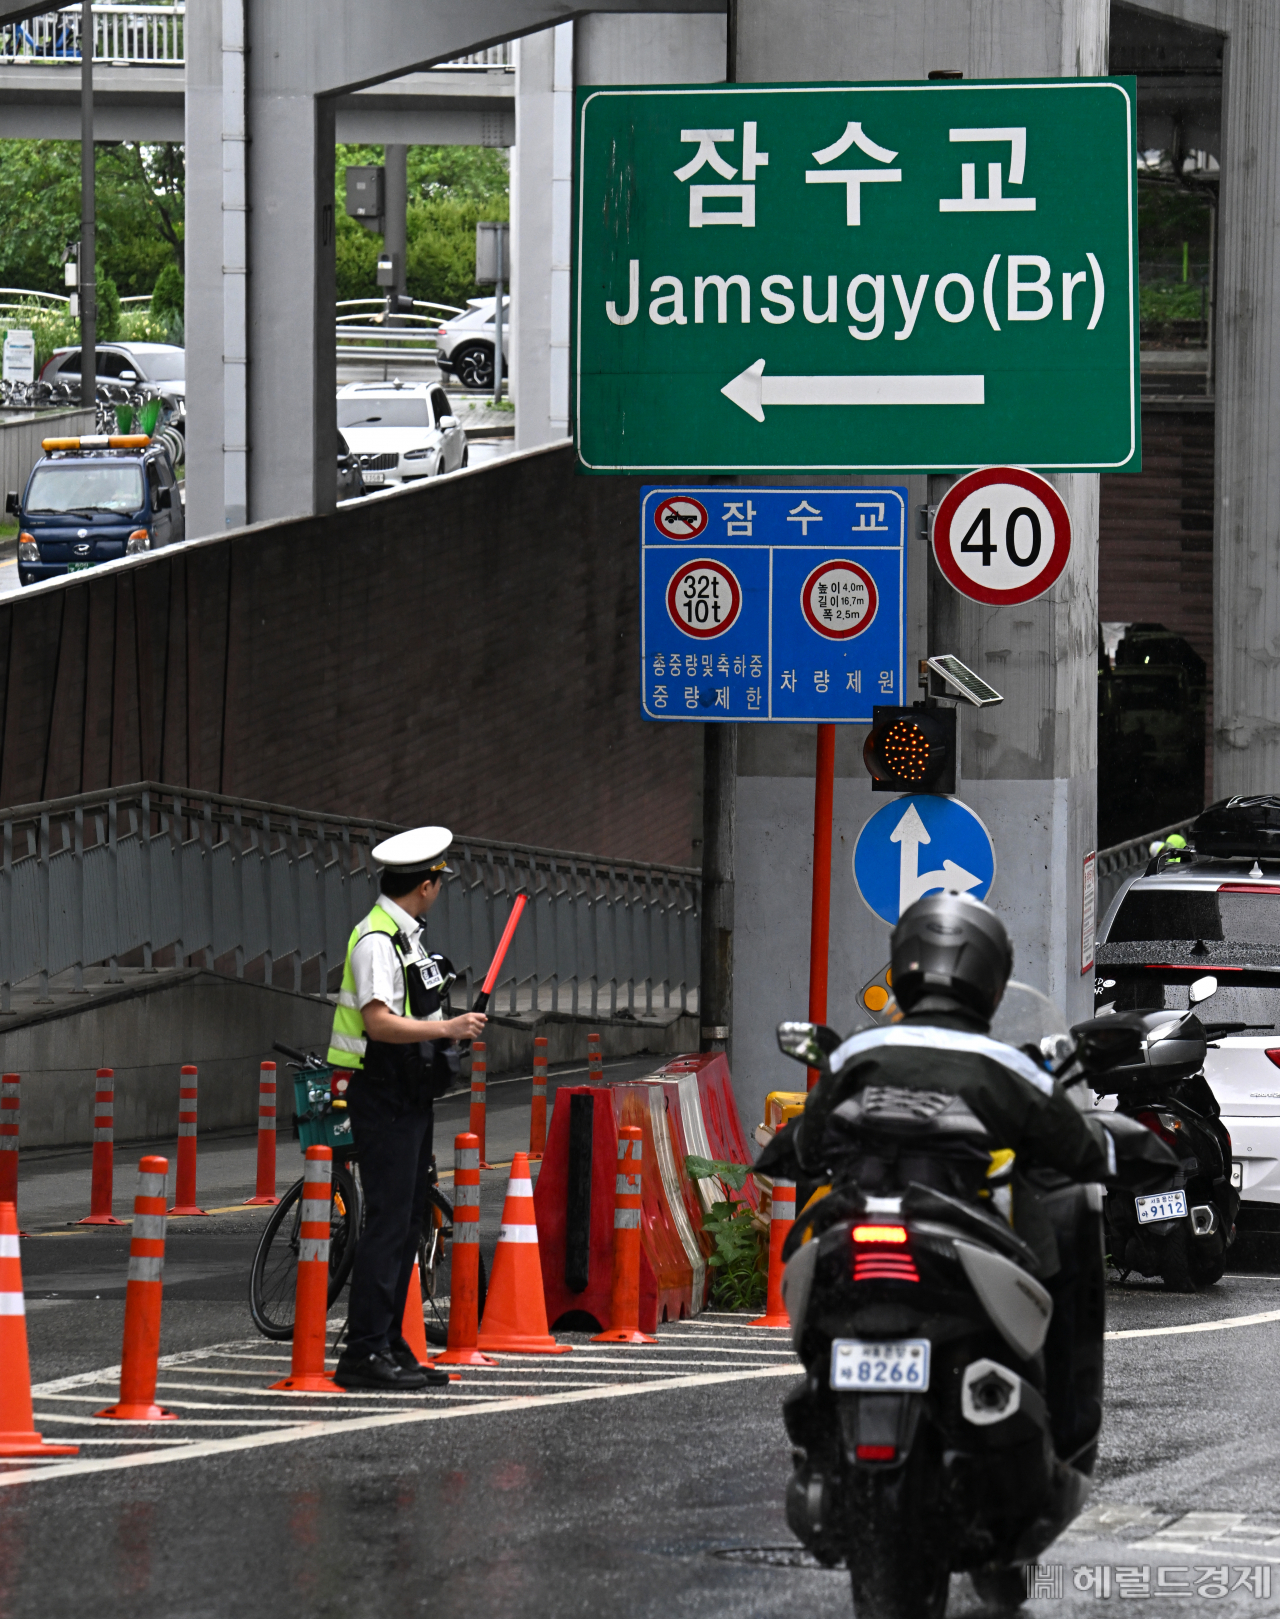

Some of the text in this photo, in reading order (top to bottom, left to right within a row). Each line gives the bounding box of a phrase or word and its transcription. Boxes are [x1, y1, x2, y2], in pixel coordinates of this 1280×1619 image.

[673, 121, 1037, 228] 잠수교
[605, 252, 1106, 341] Jamsugyo(Br)
[721, 499, 889, 537] 잠수교
[961, 506, 1042, 568] 40
[683, 575, 719, 599] 32t
[817, 581, 864, 594] 높이 4.0m
[682, 599, 721, 623] 10t
[818, 595, 865, 608] 길이 16.7m
[822, 608, 860, 621] 폭 2.5m
[780, 669, 895, 694] 차량제원
[652, 685, 762, 711] 중량제한
[1150, 1201, 1184, 1217] 9112
[858, 1361, 919, 1382] 8266
